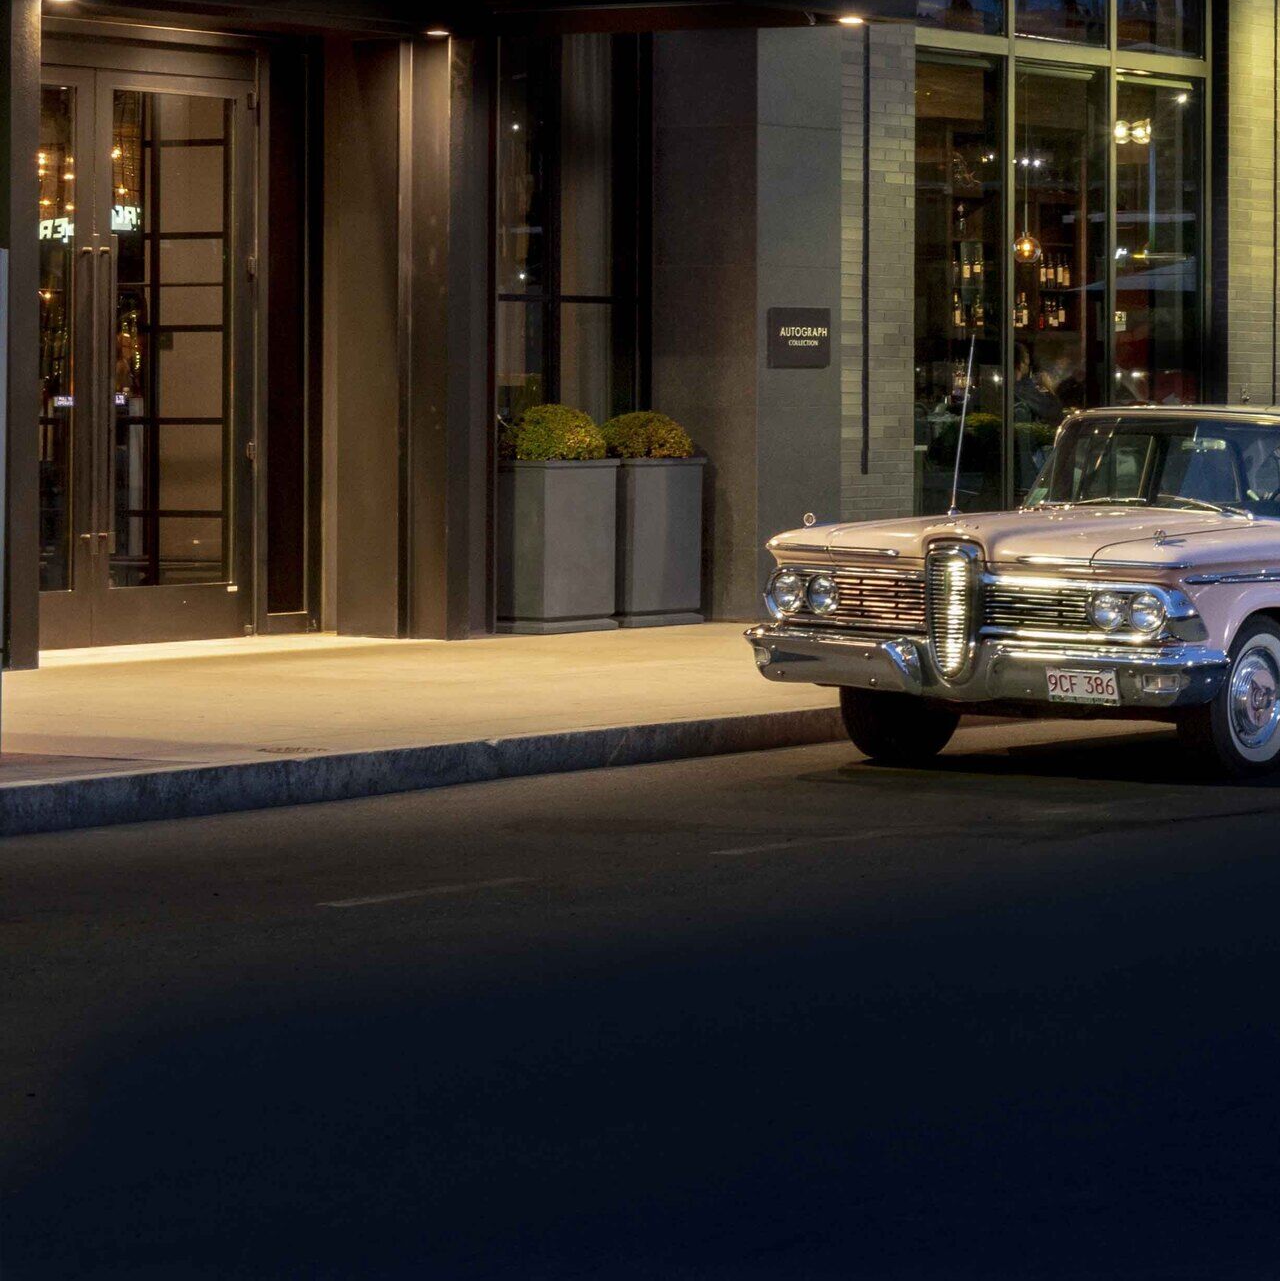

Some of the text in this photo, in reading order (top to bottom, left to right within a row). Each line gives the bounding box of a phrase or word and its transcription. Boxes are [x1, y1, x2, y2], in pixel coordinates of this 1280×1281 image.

[779, 327, 828, 337] AUTOGRAPH
[1048, 674, 1115, 695] 9CF 386
